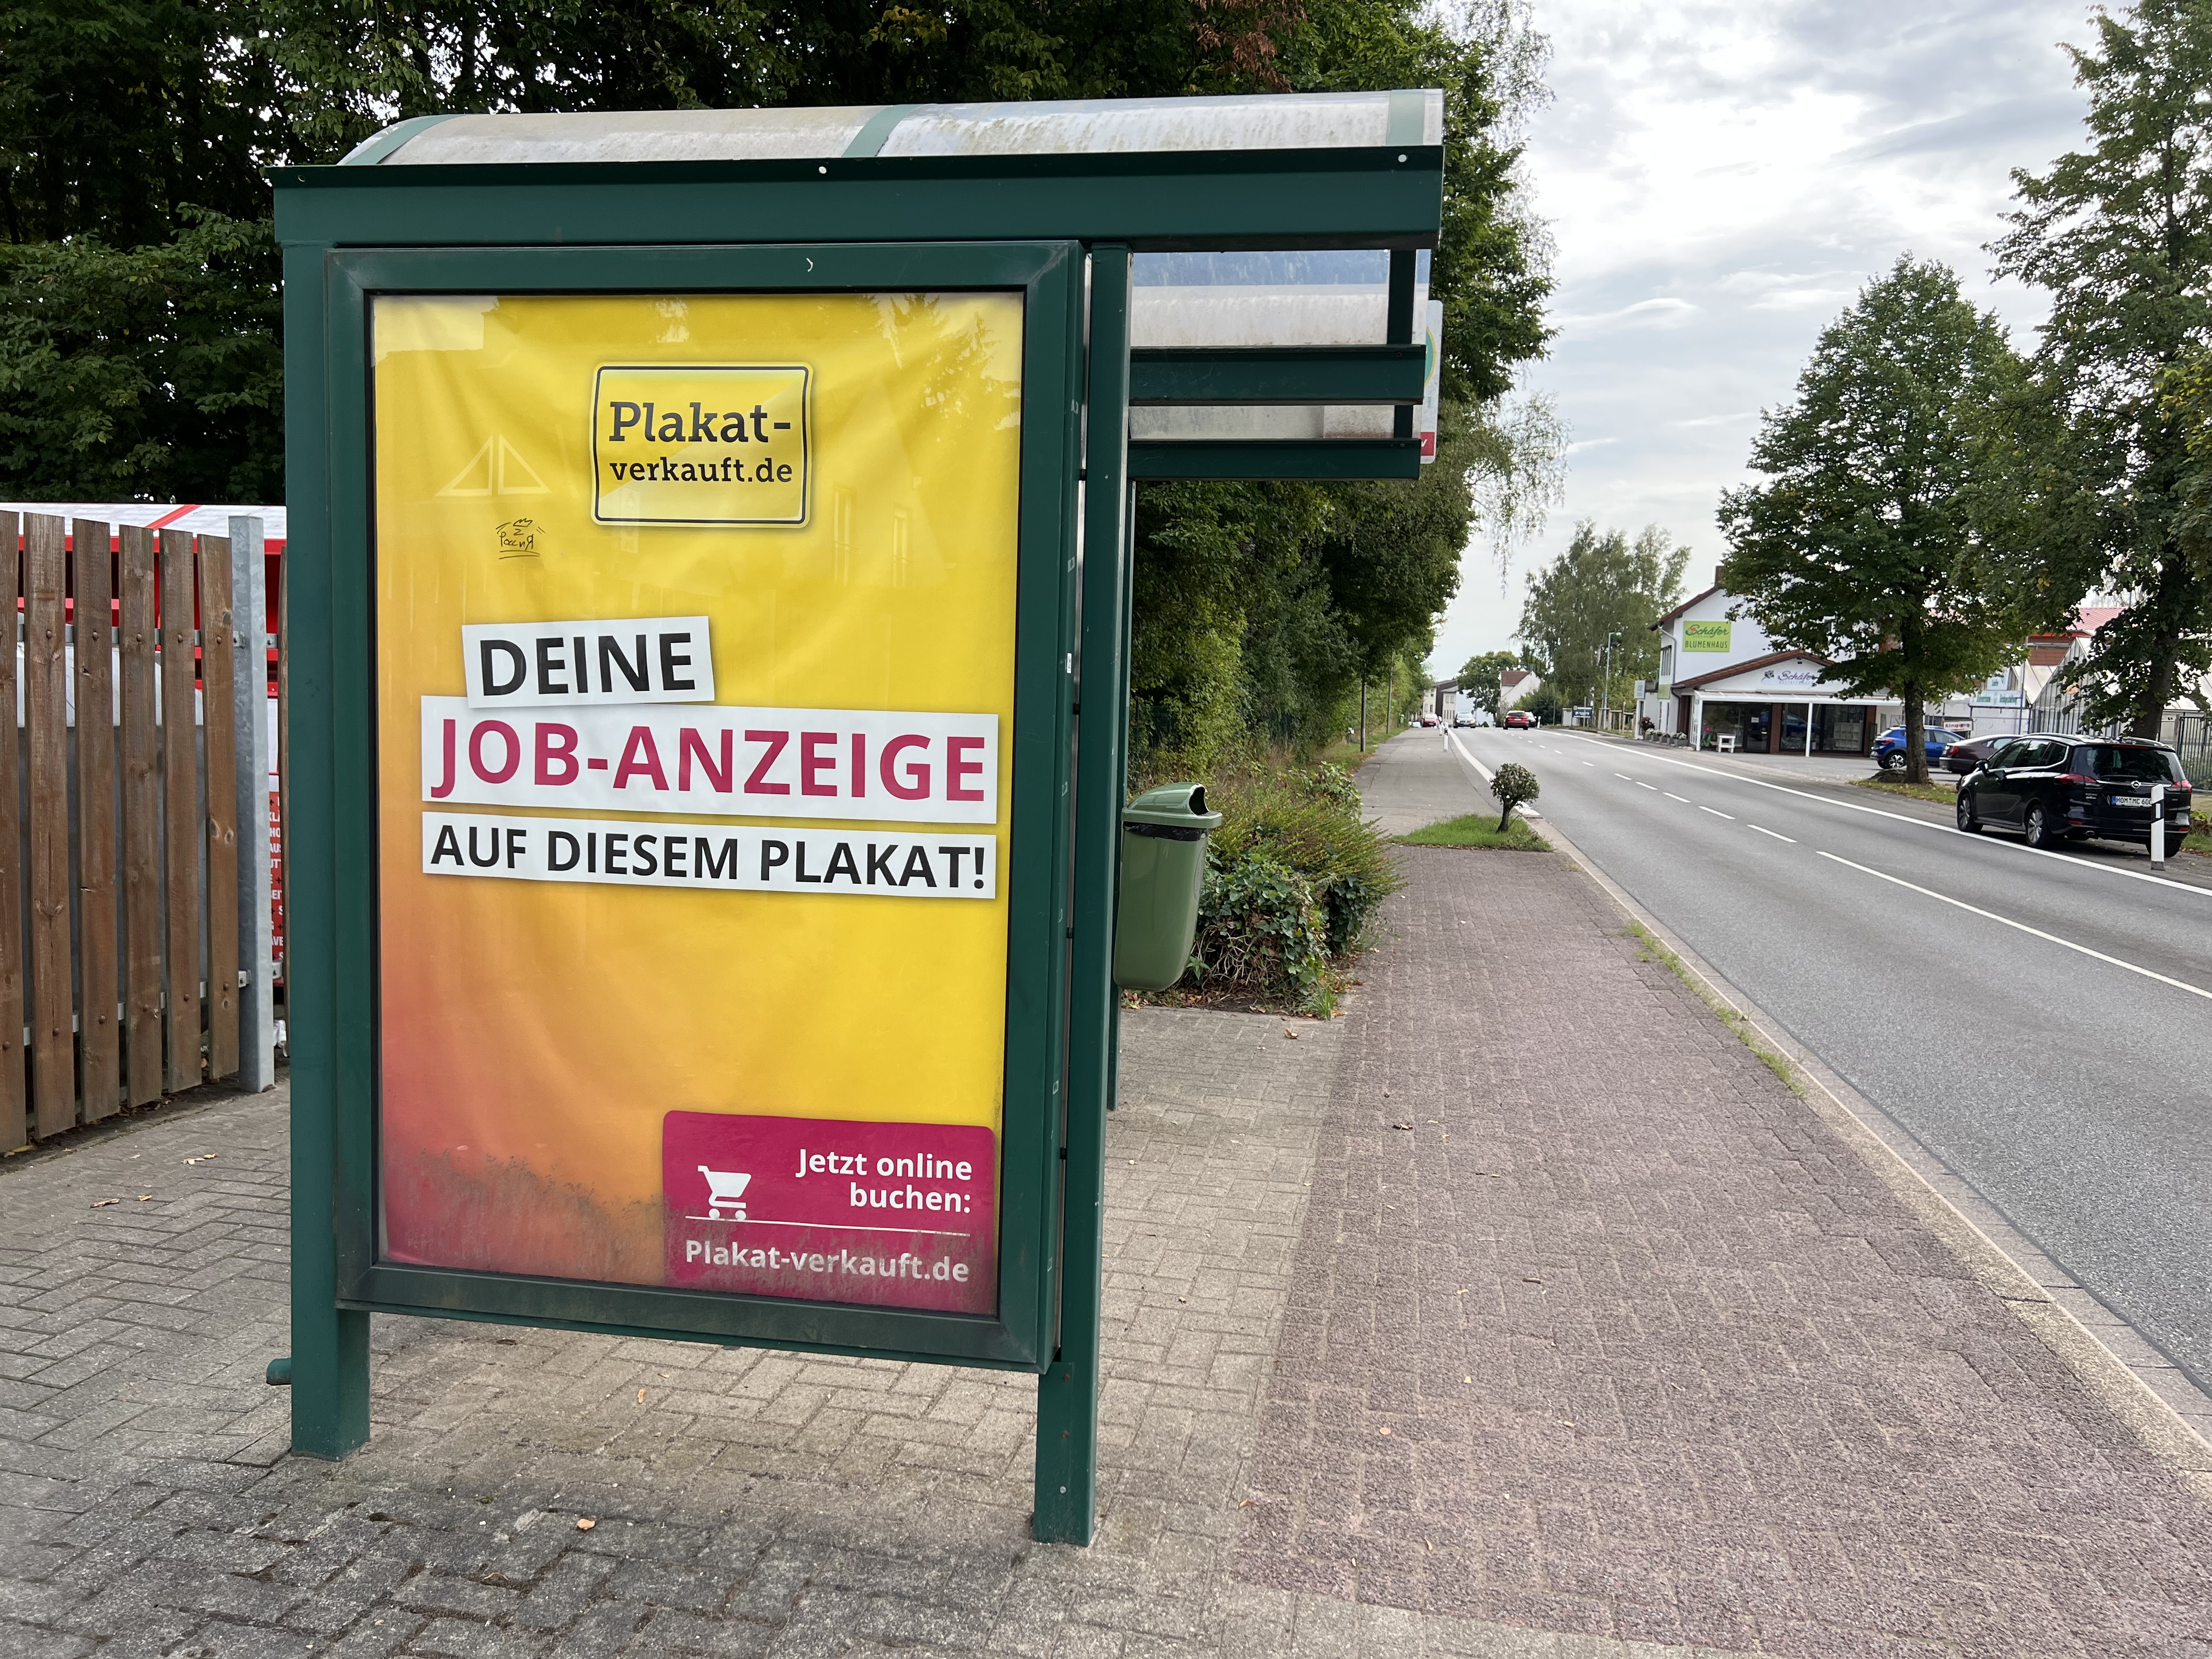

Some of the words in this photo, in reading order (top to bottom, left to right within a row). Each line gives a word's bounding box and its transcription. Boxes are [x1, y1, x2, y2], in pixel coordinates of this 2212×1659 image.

[610, 402, 791, 442] Plakat-
[610, 457, 792, 482] verkauft.de
[1685, 624, 1729, 638] Schäfer
[481, 633, 695, 696] DEINE
[1778, 670, 1813, 682] Schäfe
[431, 719, 985, 801] JOB-ANZEIGE
[431, 825, 526, 868] AUF
[548, 831, 737, 880] DIESEM
[760, 839, 985, 890] PLAKAT!
[795, 1149, 867, 1177] Jetzt
[877, 1153, 972, 1180] online
[851, 1182, 970, 1213] buchen:
[686, 1240, 969, 1282] Plakat-verkauft.de
